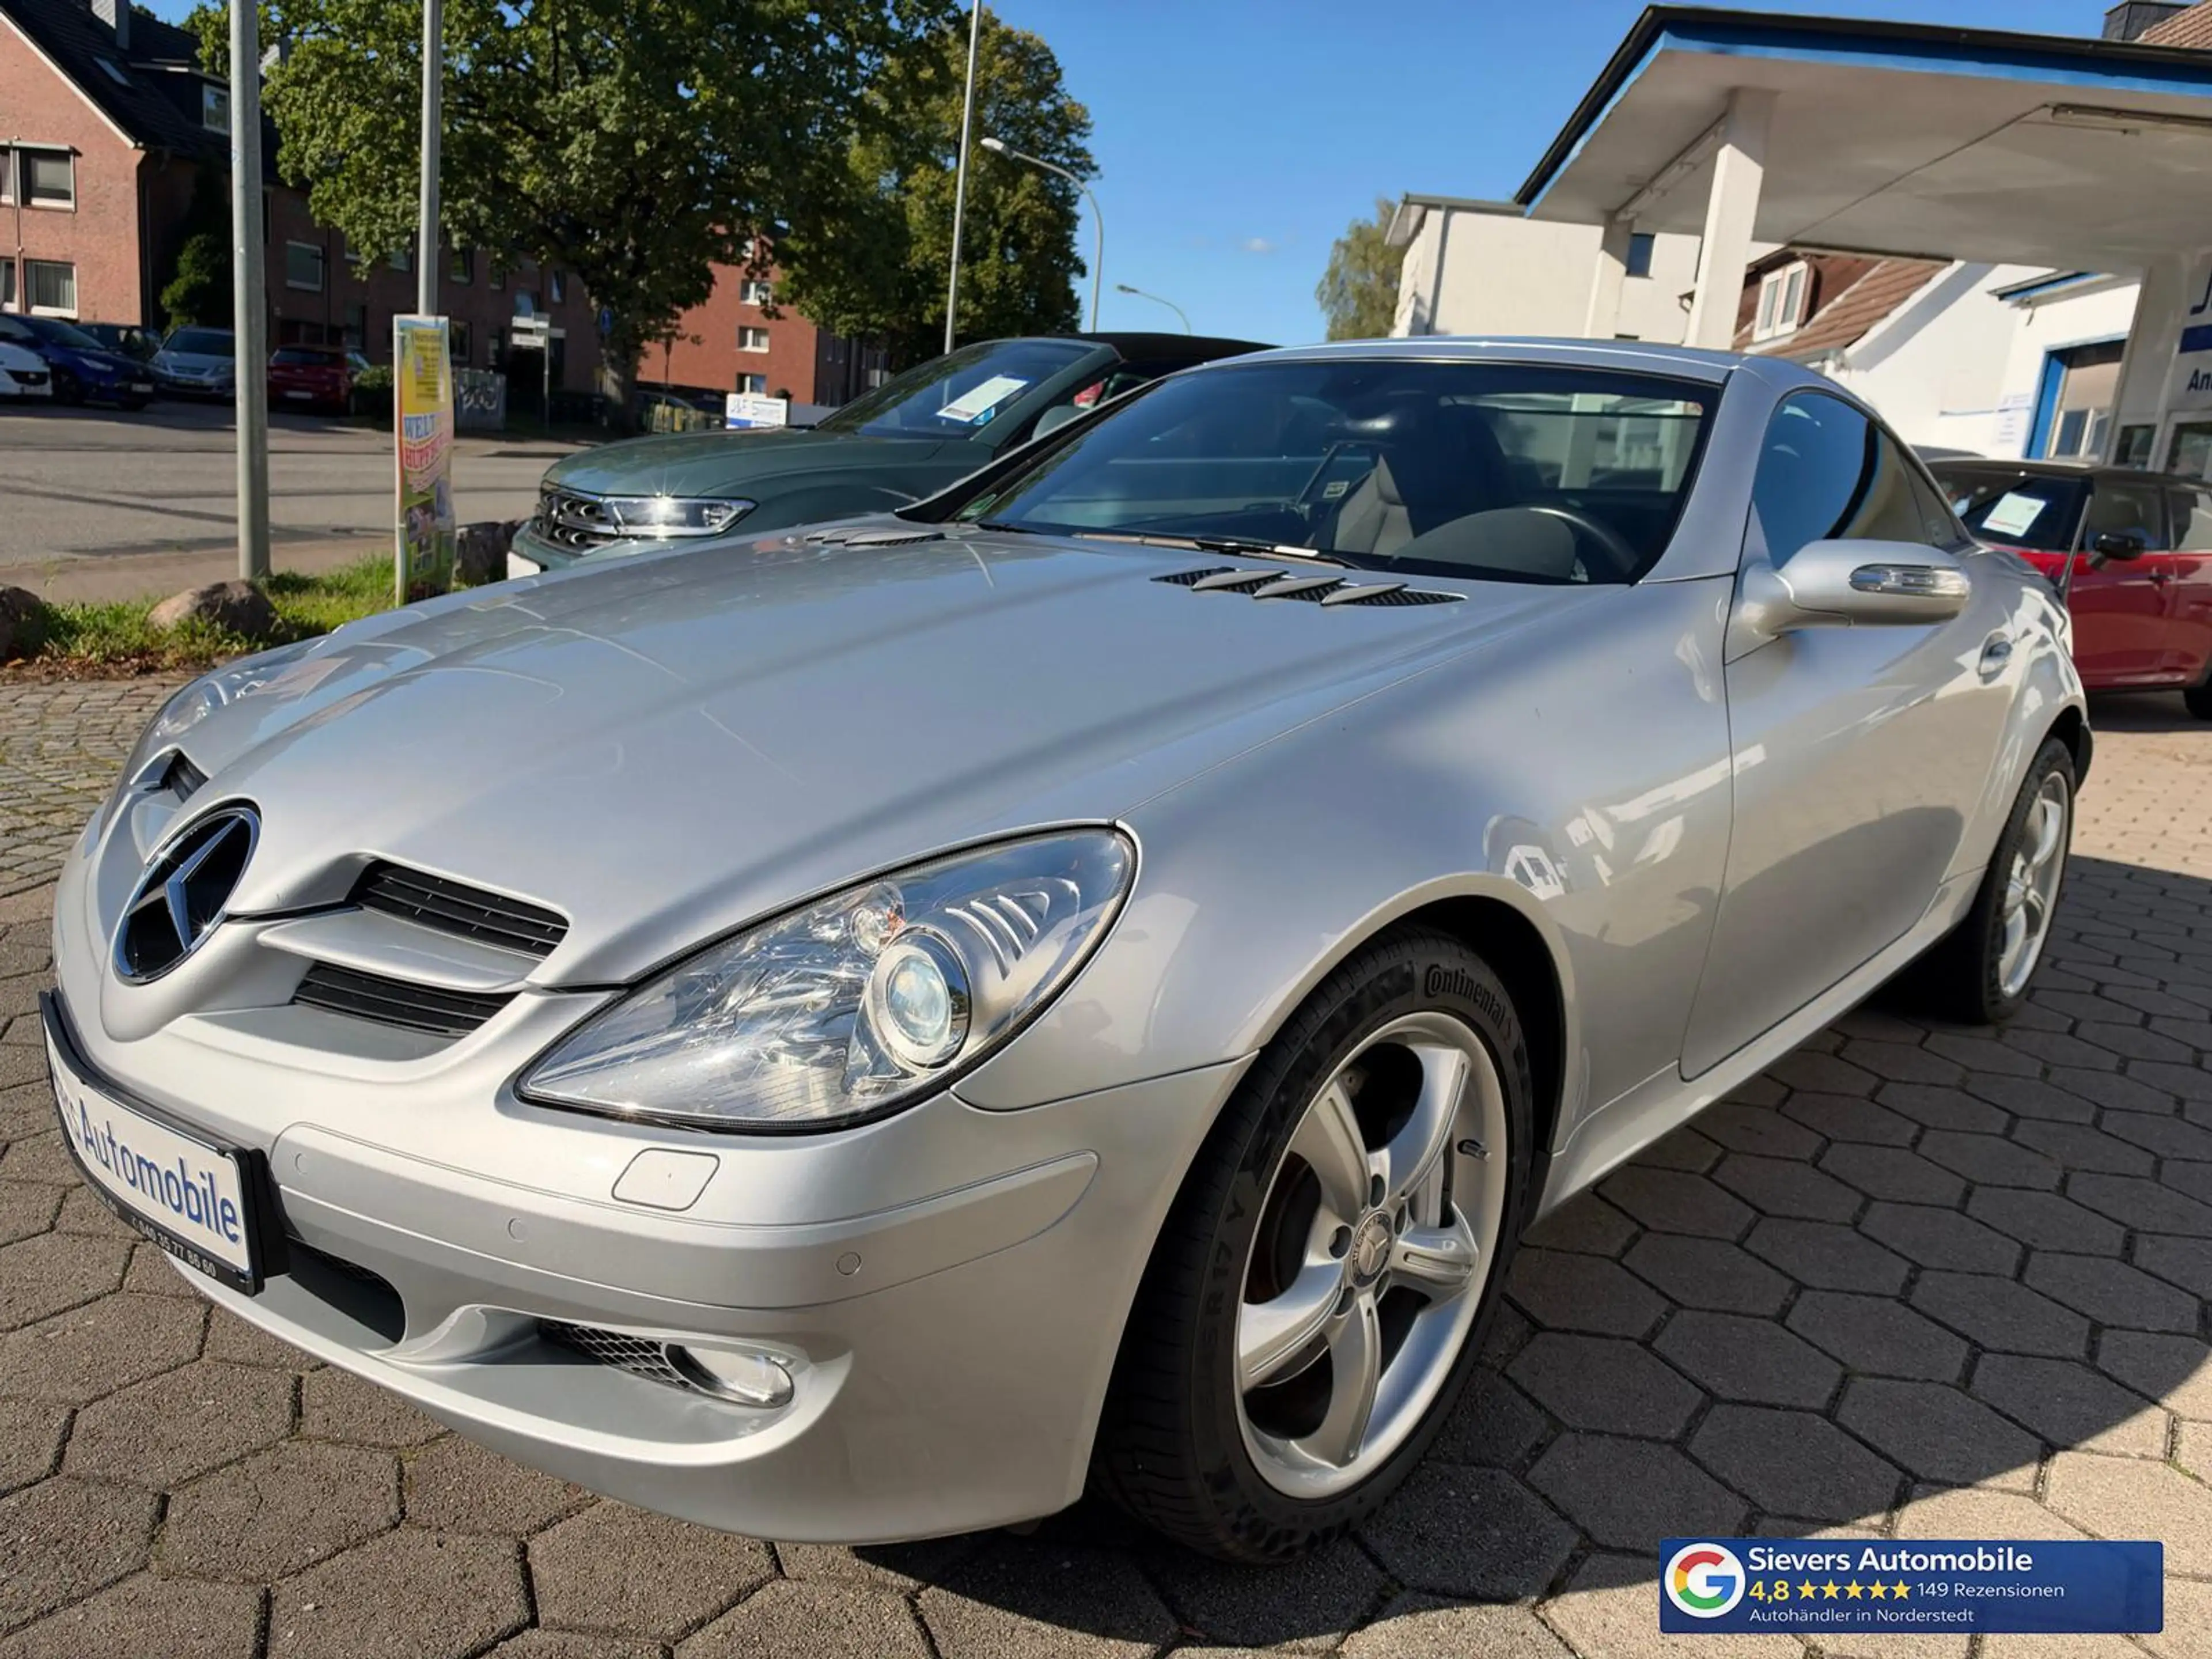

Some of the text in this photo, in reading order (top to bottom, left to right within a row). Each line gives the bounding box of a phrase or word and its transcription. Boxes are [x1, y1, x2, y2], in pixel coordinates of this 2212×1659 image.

[2187, 369, 2212, 391] An
[1425, 963, 1506, 1029] Continental
[79, 1097, 238, 1243] Automobile
[172, 1240, 184, 1258] 77
